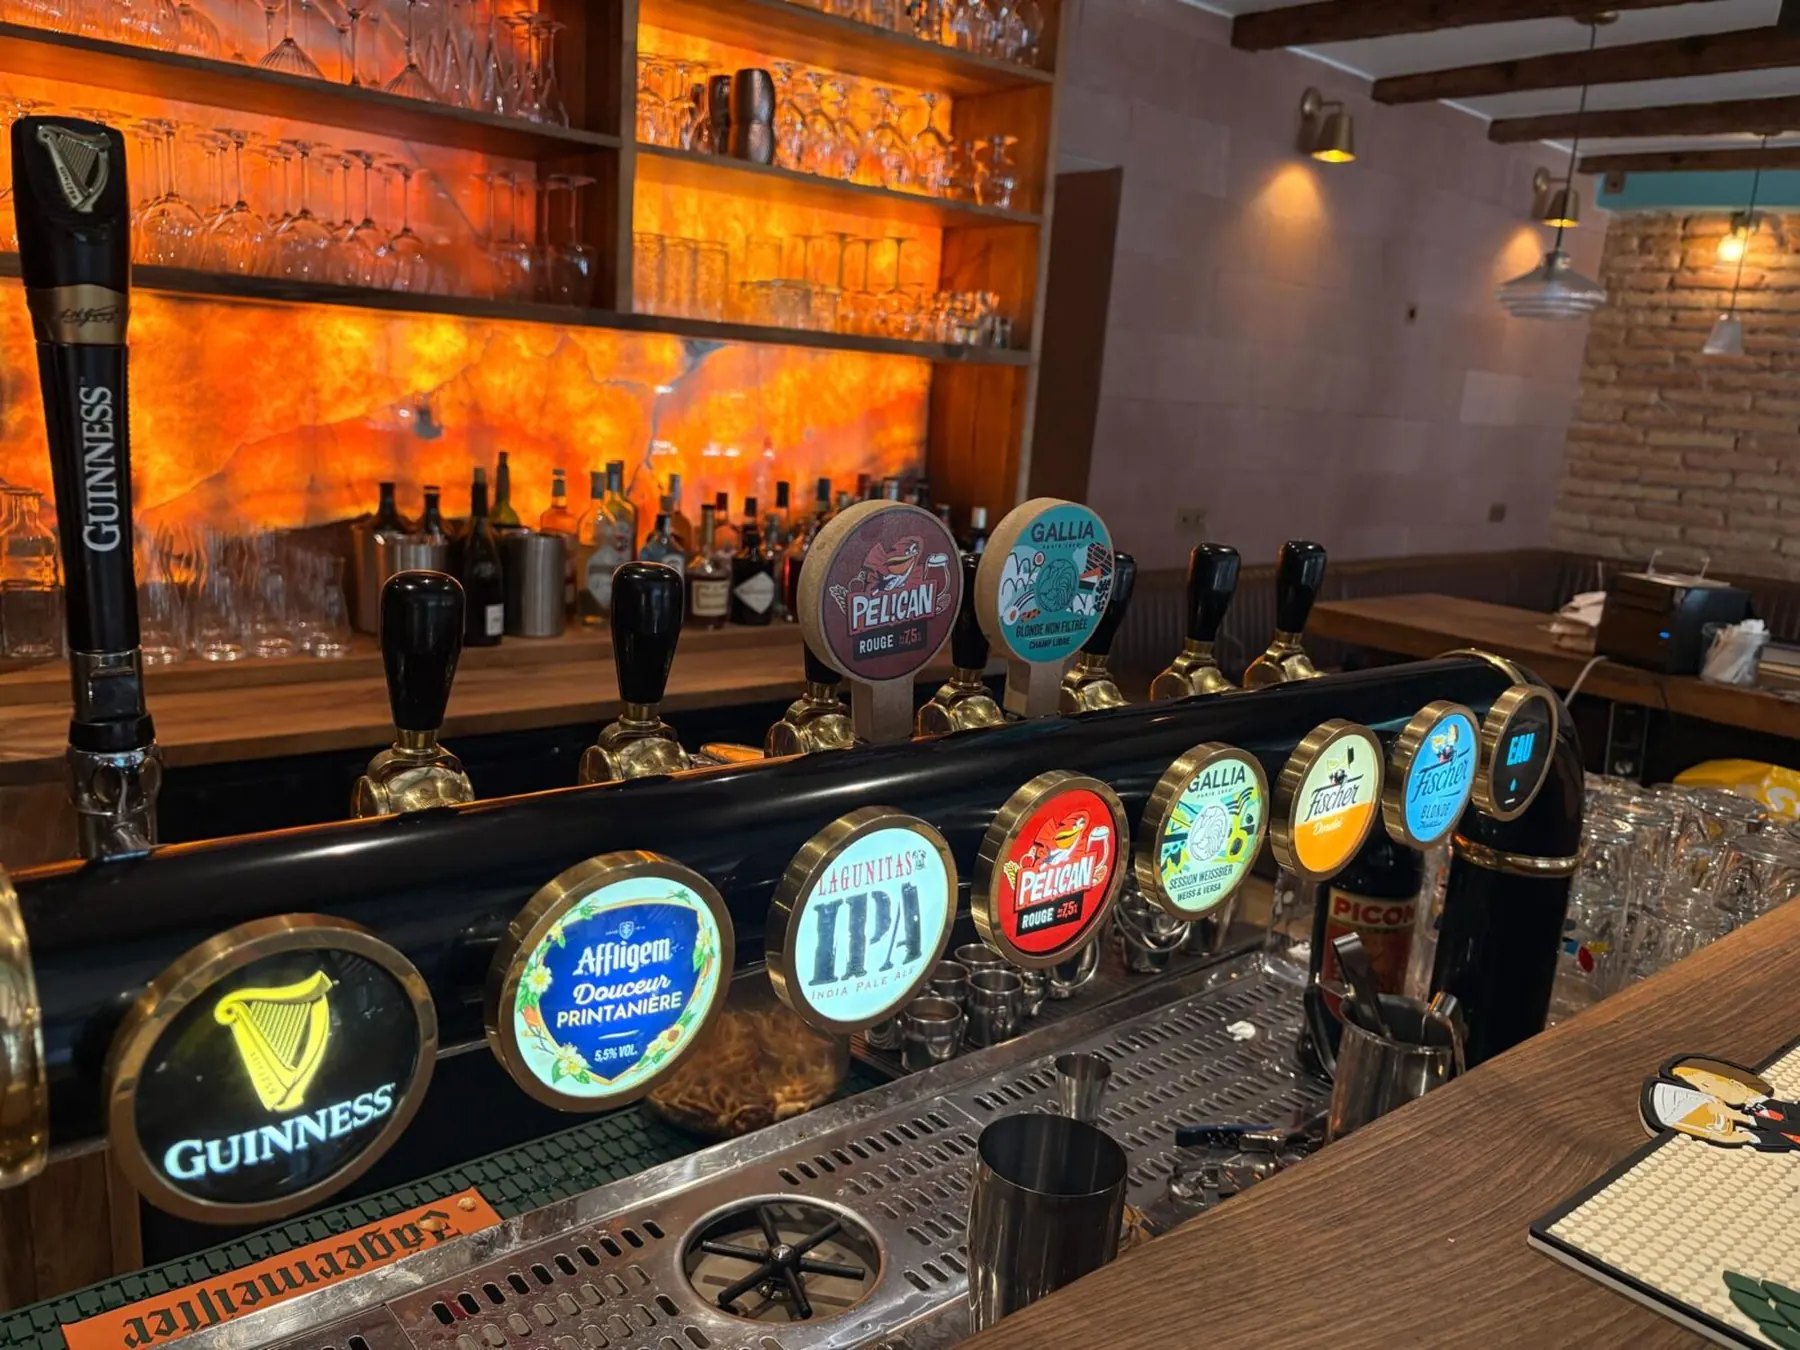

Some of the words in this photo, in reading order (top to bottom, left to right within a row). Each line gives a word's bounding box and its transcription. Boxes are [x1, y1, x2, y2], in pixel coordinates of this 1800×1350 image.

[79, 386, 121, 551] GUINNESS
[1031, 520, 1094, 543] GALLIA
[859, 634, 894, 654] ROUGE
[1506, 732, 1535, 766] EAU
[1187, 765, 1246, 793] GALLIA
[1411, 754, 1469, 803] Fischer
[1304, 776, 1362, 822] Fischer
[817, 850, 912, 896] LAGUNITAS
[1169, 873, 1198, 890] SESSION
[1177, 888, 1196, 901] WEISS
[1022, 907, 1054, 929] ROUGE
[808, 882, 922, 987] IPA
[572, 938, 673, 977] Affligem
[573, 974, 671, 1004] Douceur
[811, 987, 848, 1000] INDIA
[856, 976, 888, 992] PALE
[556, 990, 682, 1029] PRINTANIÈRE
[619, 1044, 638, 1057] VOL.
[163, 1083, 396, 1180] GUINNESS
